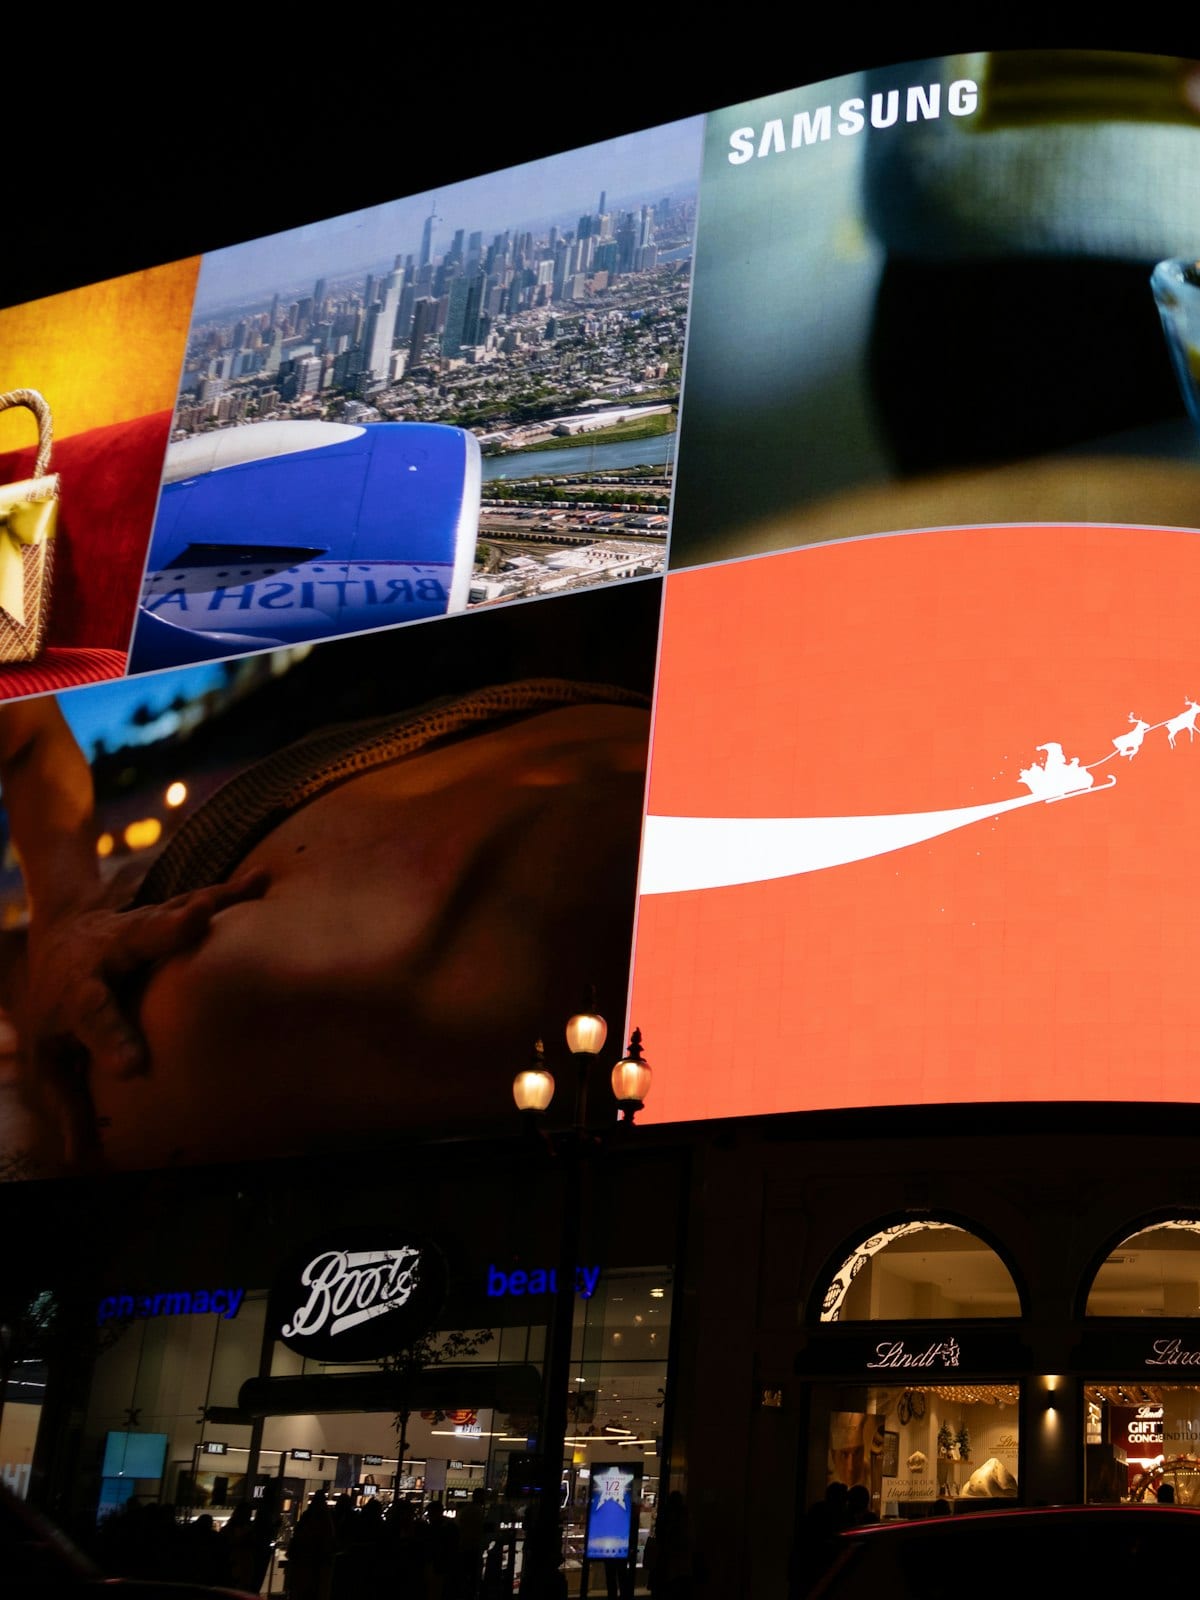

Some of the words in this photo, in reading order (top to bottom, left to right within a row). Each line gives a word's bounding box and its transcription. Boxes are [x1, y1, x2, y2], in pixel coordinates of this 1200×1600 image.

[728, 79, 978, 165] SAMSUNG
[282, 1245, 420, 1338] Boots
[486, 1263, 602, 1299] beay
[866, 1340, 943, 1368] Lindt
[1127, 1421, 1155, 1434] GIFT
[605, 1481, 620, 1491] 1/2
